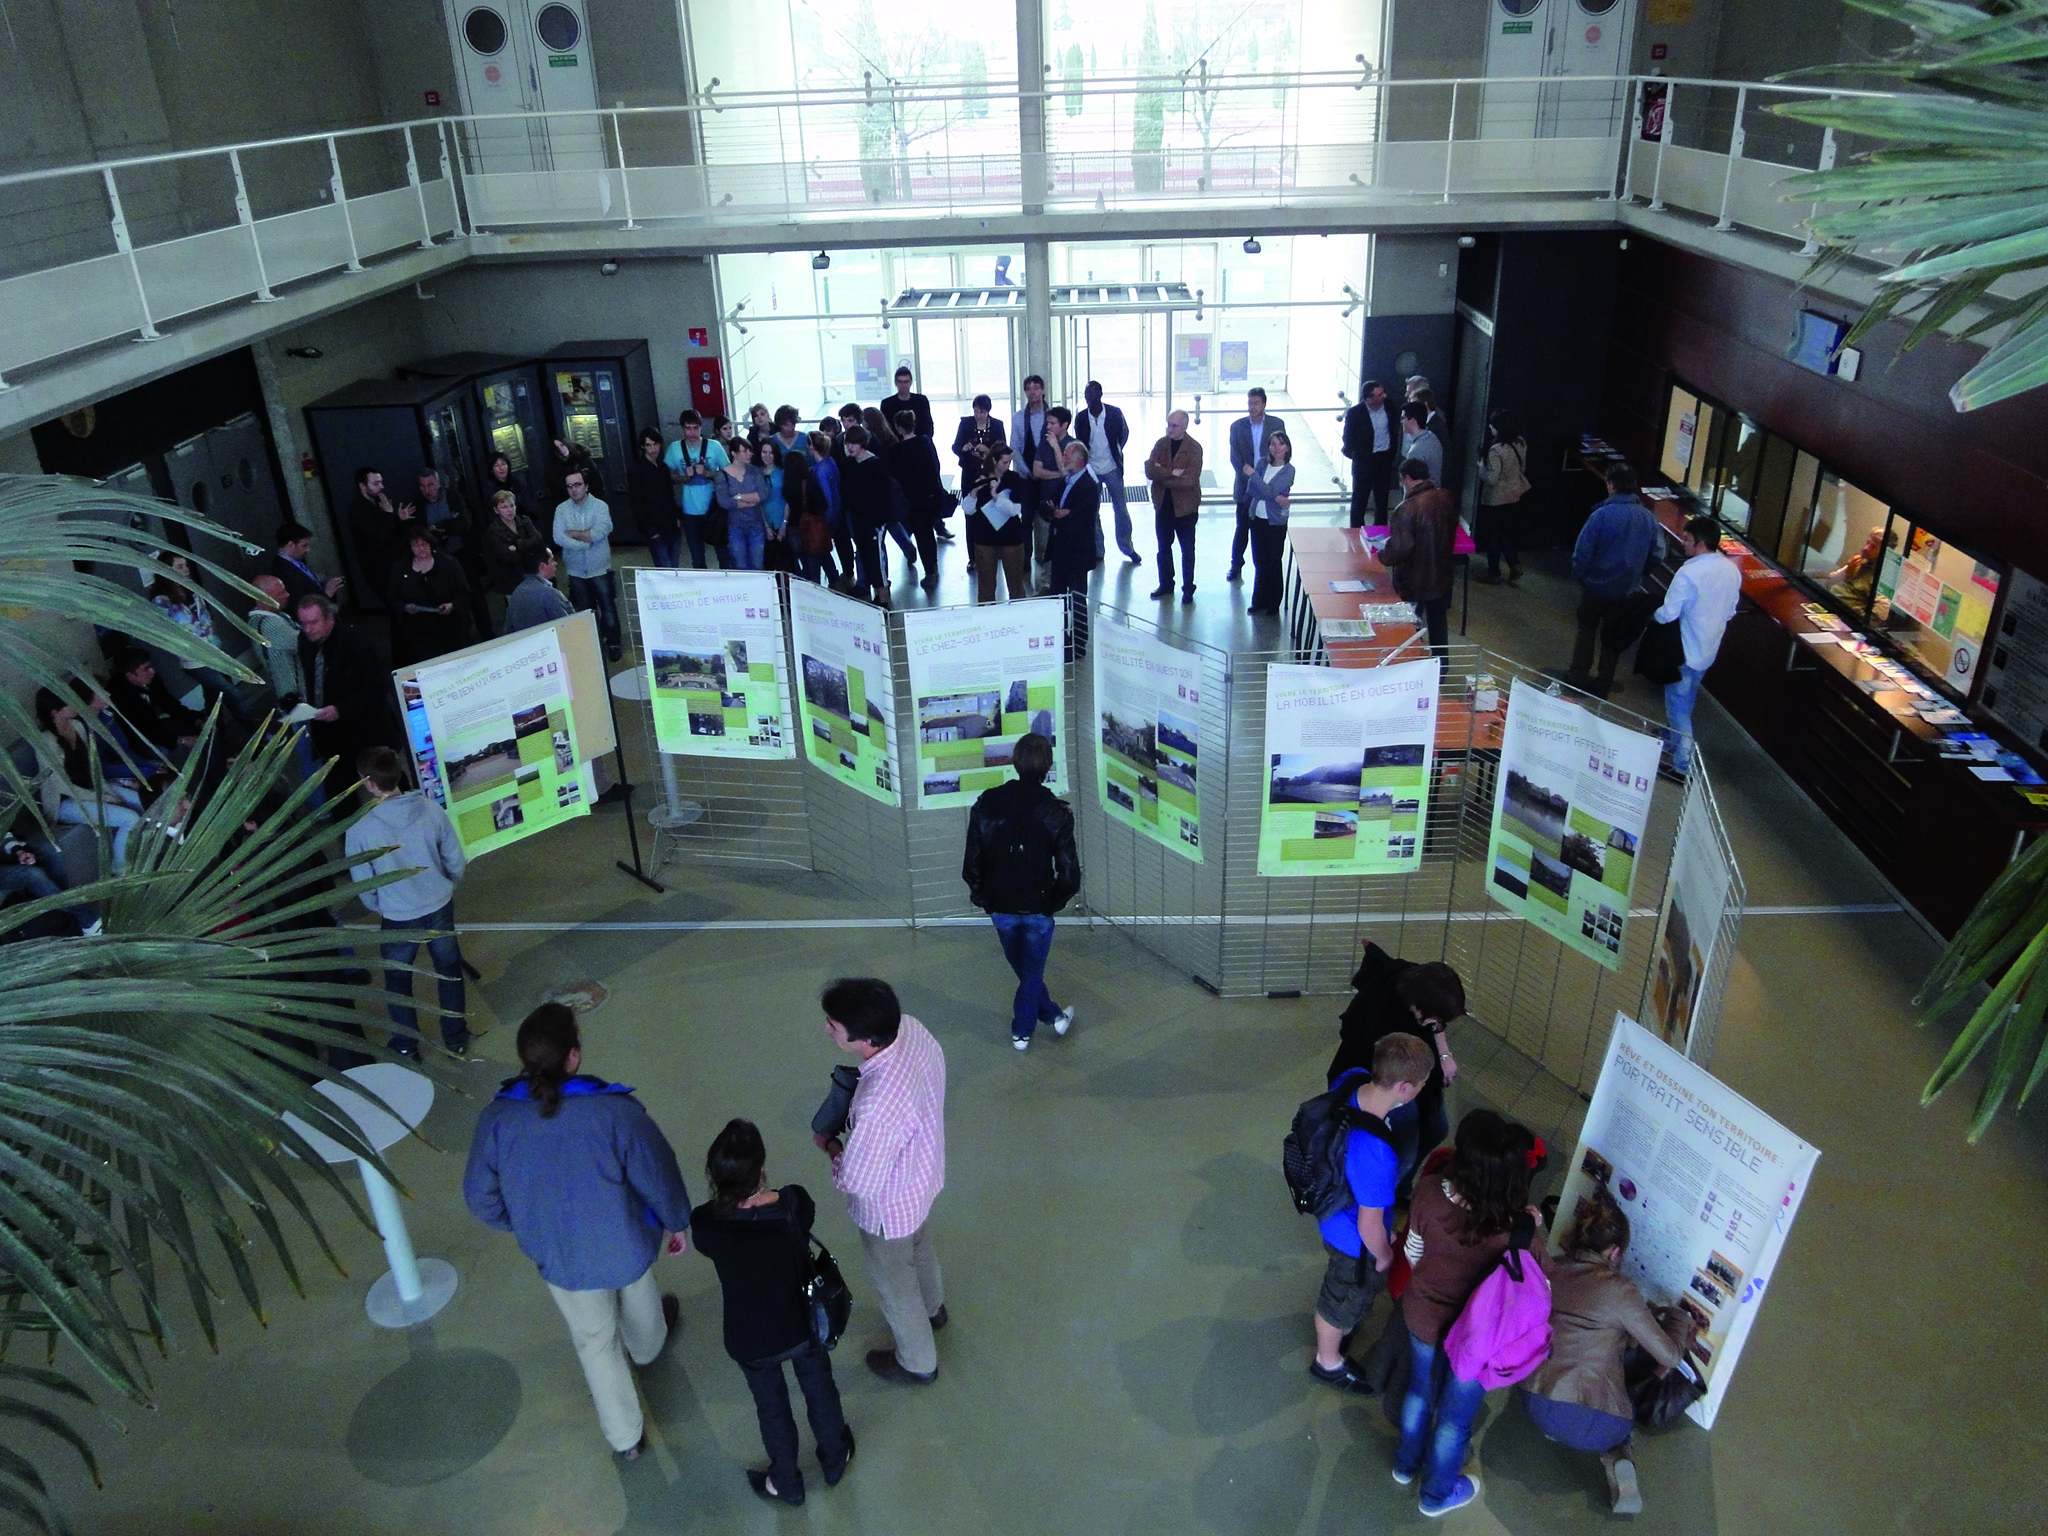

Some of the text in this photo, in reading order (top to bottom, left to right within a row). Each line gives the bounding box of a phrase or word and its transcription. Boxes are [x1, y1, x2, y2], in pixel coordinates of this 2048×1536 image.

[647, 593, 749, 611] LE BESOIN DE NATURE
[916, 646, 929, 656] LE
[931, 634, 981, 653] CHEZ-SOI
[432, 646, 551, 709] LE "BIEN VIVRE ENSEMBLE"
[1156, 664, 1193, 680] QUESTION
[1275, 690, 1297, 699] VIVRE
[1308, 683, 1350, 696] TERRITOIRE
[1276, 679, 1424, 711] LA MOBILITÉ EN QUESTION
[1528, 725, 1571, 744] RAPPORT
[1574, 736, 1619, 760] AFFECTIF
[1614, 1055, 1684, 1114] PORTRAIT
[1684, 1109, 1763, 1175] SENSIBLE
[1619, 1042, 1642, 1064] RÊVE
[1643, 1062, 1656, 1073] ET
[1656, 1070, 1695, 1104] DESSINE
[1697, 1098, 1718, 1120] TON
[1719, 1115, 1779, 1164] TERRITOIRE
